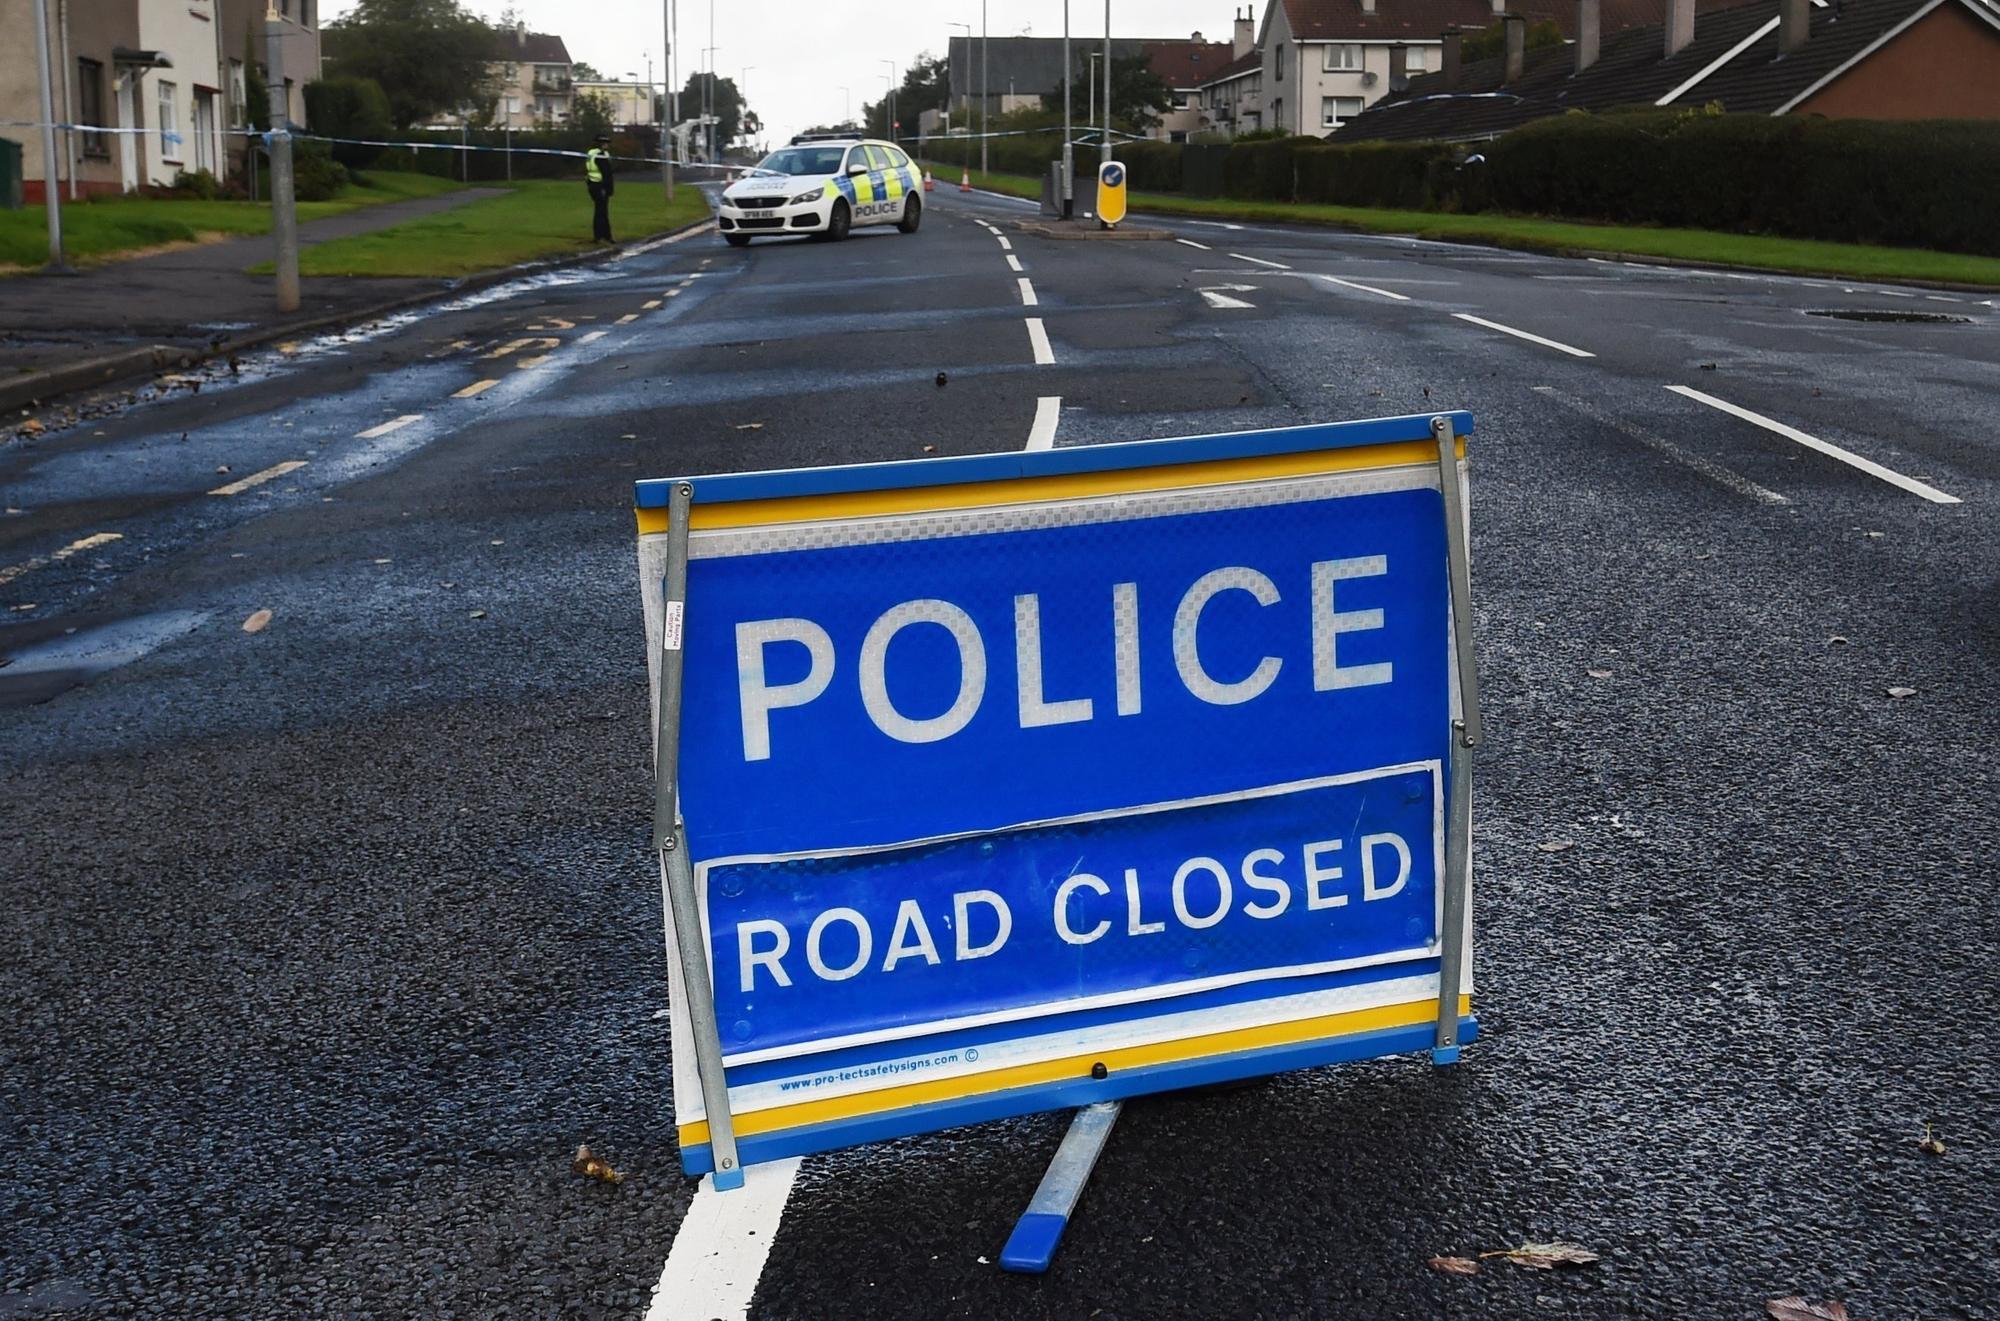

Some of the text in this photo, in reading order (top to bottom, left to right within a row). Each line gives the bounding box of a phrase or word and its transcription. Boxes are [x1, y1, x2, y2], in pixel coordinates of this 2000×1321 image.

[855, 201, 897, 218] POLICE
[673, 605, 682, 647] Moving Parts
[735, 554, 1394, 762] POLICE
[737, 832, 1412, 992] ROAD CLOSED
[780, 1053, 959, 1091] www.pro-tectsafetysigns.com
